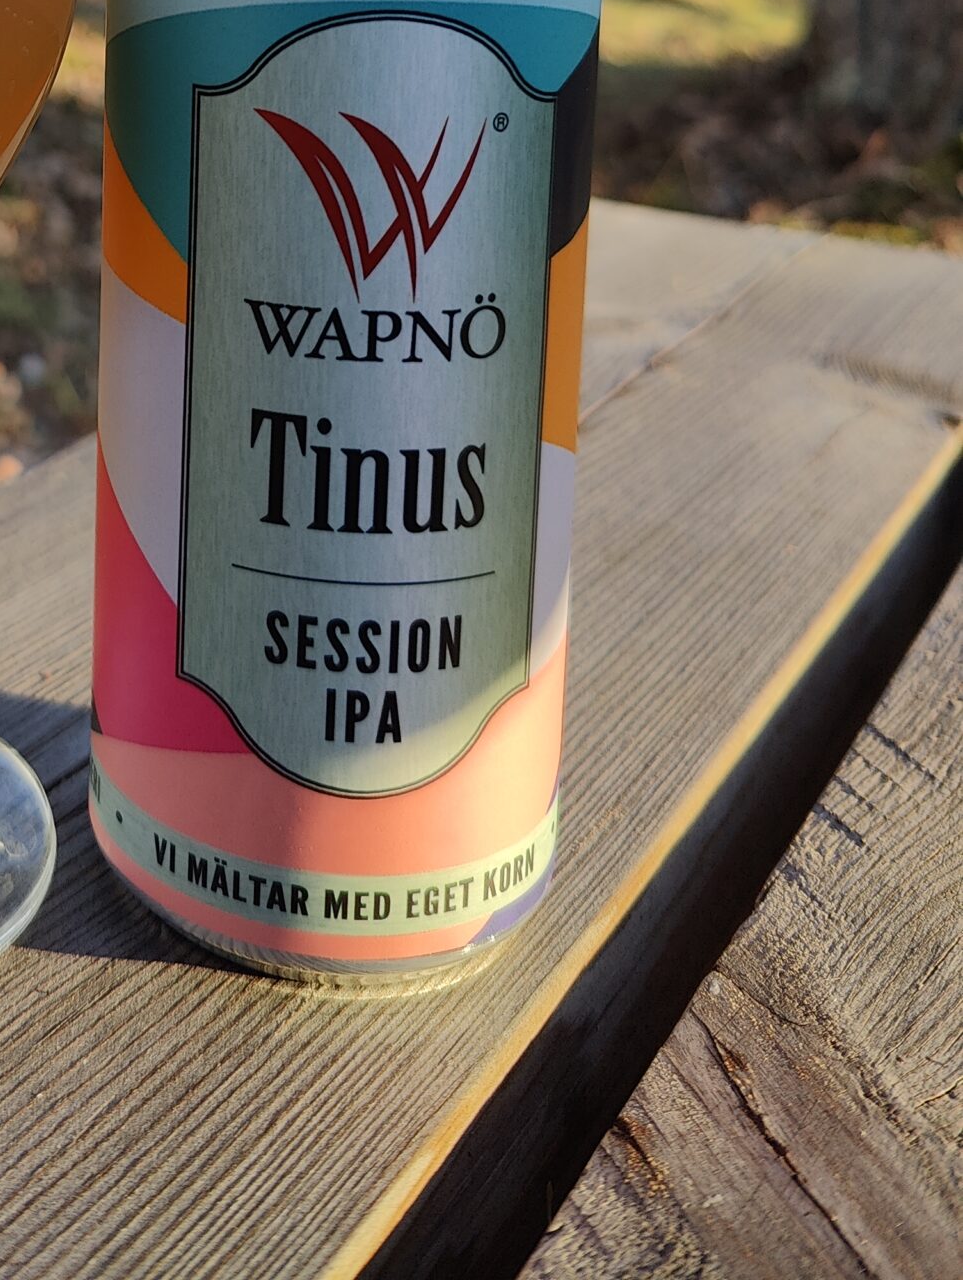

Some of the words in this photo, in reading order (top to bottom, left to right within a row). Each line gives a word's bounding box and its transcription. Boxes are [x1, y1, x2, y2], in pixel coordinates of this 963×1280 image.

[244, 292, 506, 363] WAPNÖ
[250, 407, 486, 534] Tinus
[264, 609, 462, 674] SESSION
[324, 688, 402, 744] IPA
[153, 832, 176, 873] VI
[188, 852, 309, 916] MÄLTAR
[324, 889, 391, 920] MED
[406, 877, 474, 919] EGET
[483, 842, 535, 901] KORN
